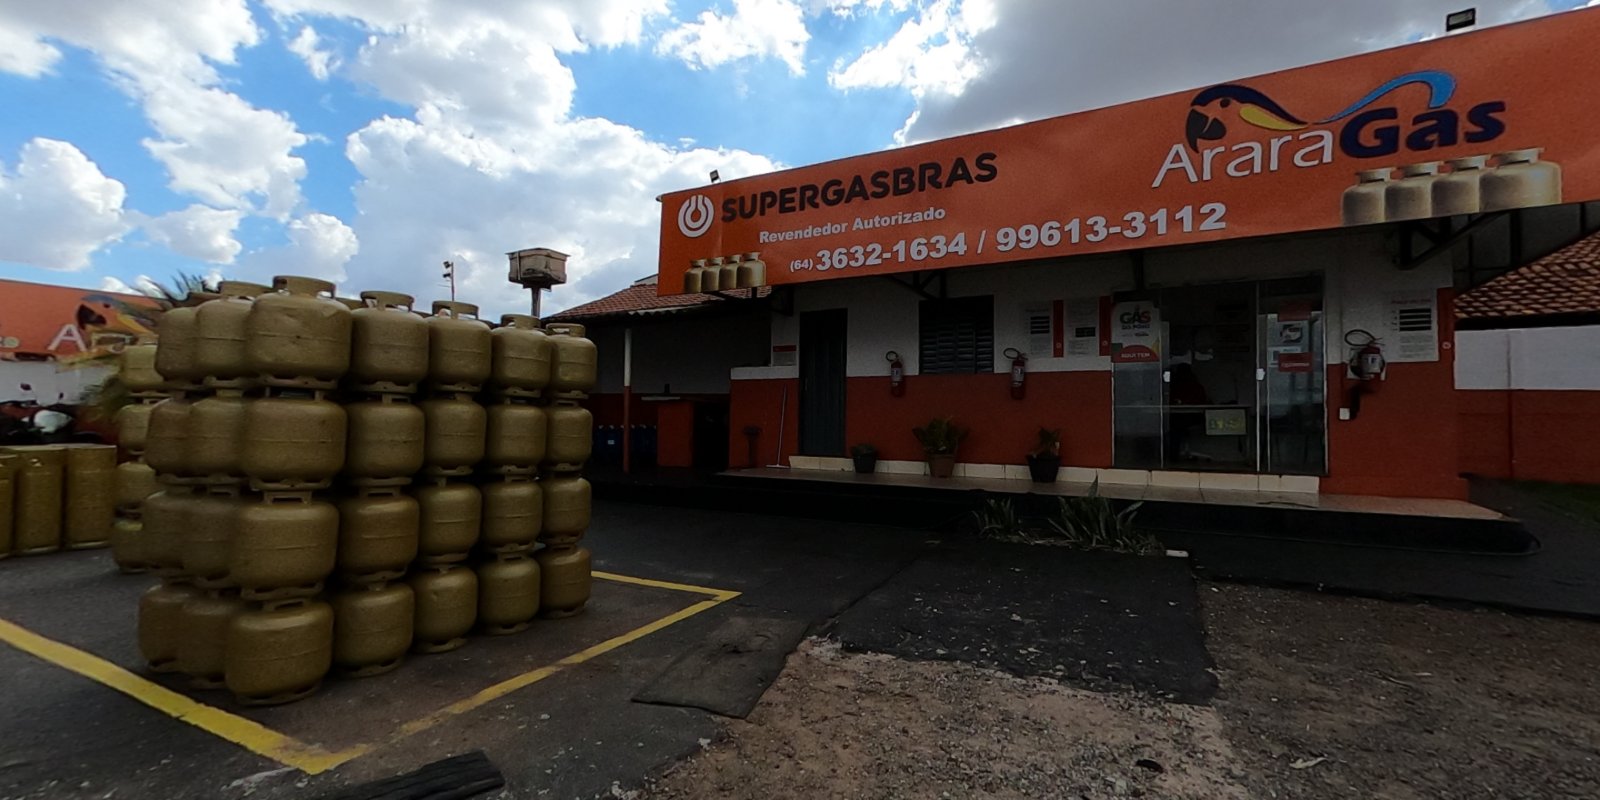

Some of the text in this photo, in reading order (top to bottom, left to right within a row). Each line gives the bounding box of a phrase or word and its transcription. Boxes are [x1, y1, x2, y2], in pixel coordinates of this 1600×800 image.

[721, 152, 998, 223] SUPERGASBRAS
[759, 206, 946, 244] Revendedor Autorizado
[790, 256, 814, 272] (64)
[815, 231, 968, 271] 3632-1634
[996, 202, 1227, 251] 99613-3112
